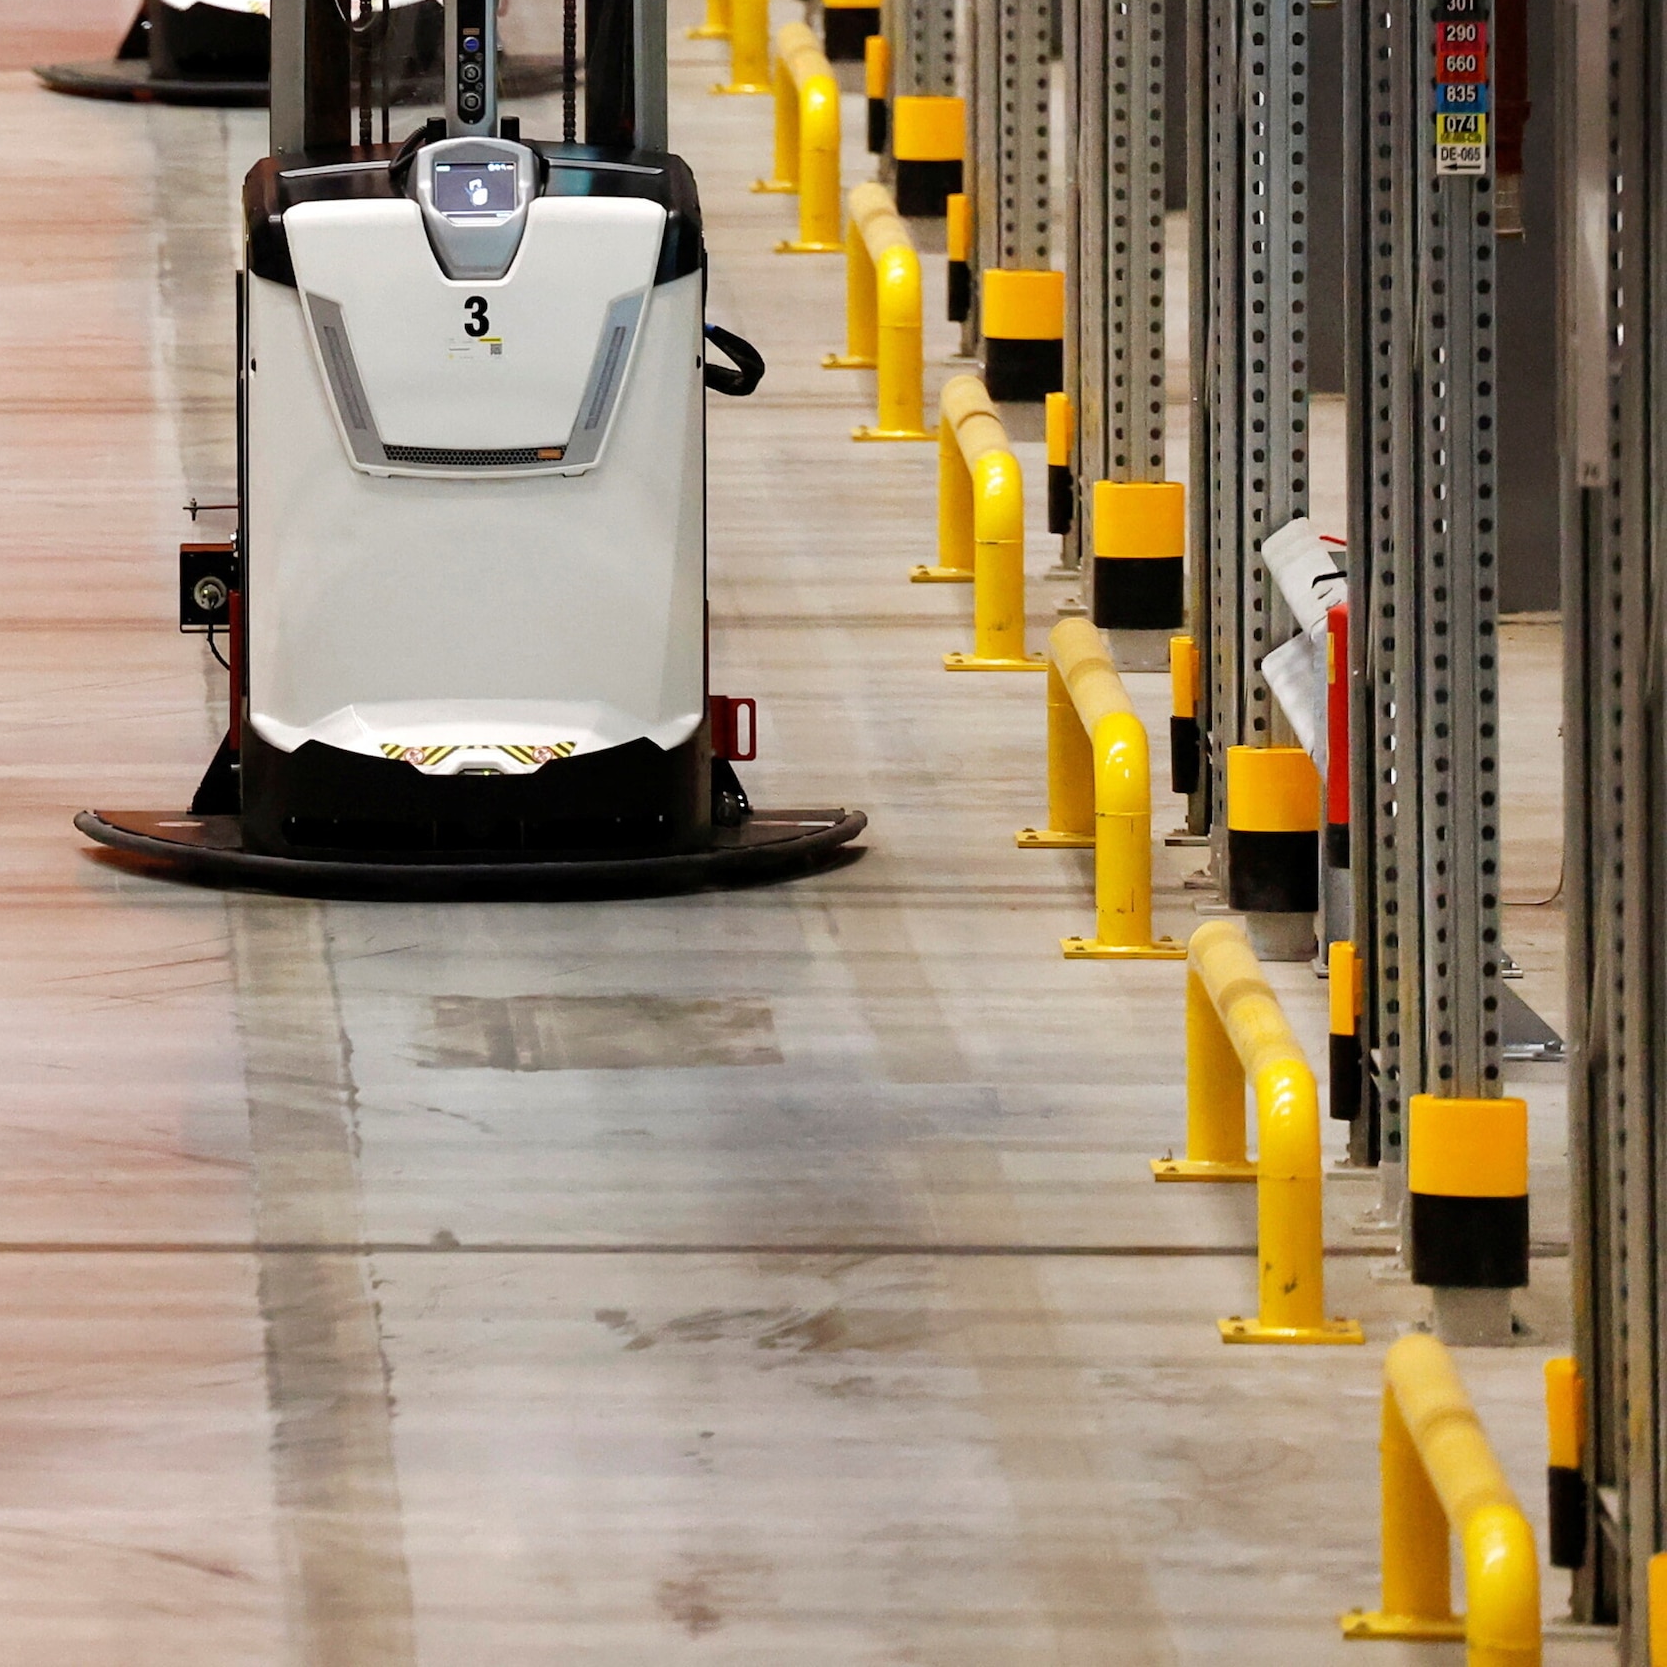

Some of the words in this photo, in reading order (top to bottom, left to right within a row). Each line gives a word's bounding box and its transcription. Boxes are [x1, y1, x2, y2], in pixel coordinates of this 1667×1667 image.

[1446, 25, 1476, 41] 290
[1446, 55, 1476, 72] 660
[1446, 85, 1476, 102] 835
[1446, 115, 1476, 132] 074
[1441, 147, 1481, 161] DE-065
[464, 295, 490, 338] 3
